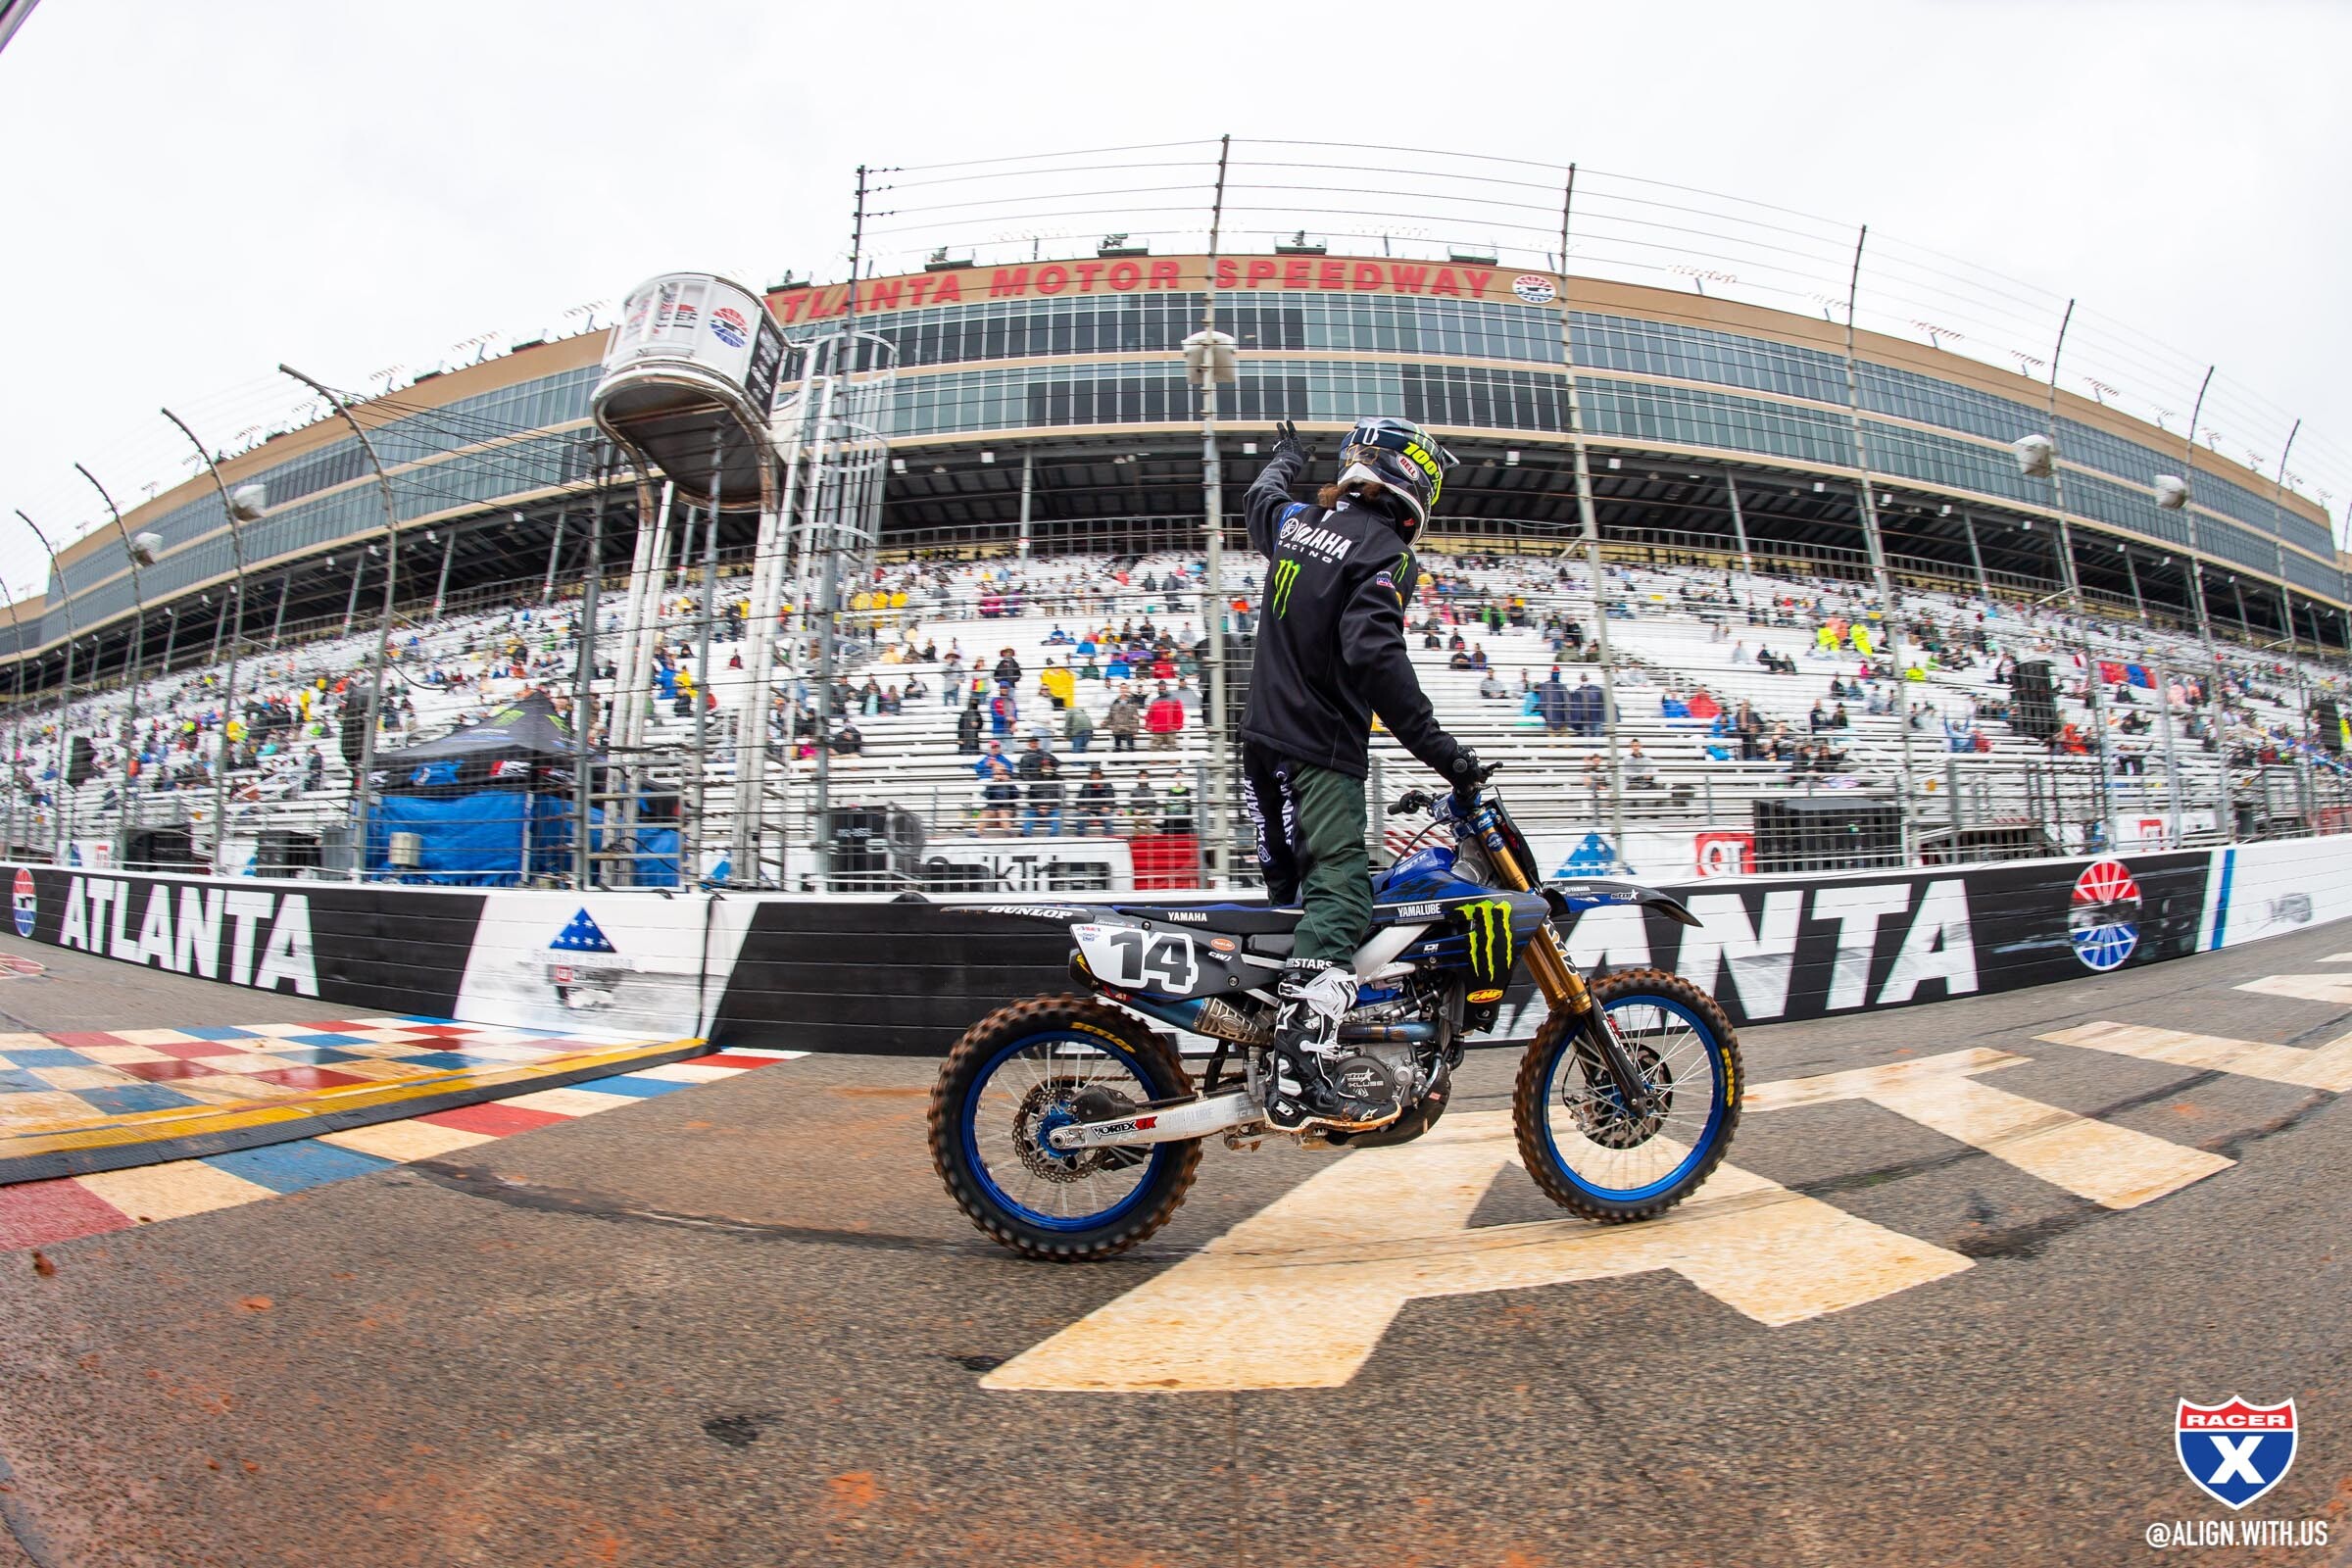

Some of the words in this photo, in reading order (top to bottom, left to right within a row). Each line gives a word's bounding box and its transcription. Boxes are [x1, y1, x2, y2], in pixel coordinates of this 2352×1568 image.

[990, 260, 1178, 297] MOTOR
[1215, 260, 1494, 298] SPEEDWAY
[1399, 458, 1416, 477] BELL
[1278, 540, 1333, 564] RACING
[1291, 521, 1352, 561] YAMAHA
[1244, 779, 1265, 843] YAMAHA
[1700, 840, 1746, 875] QT
[988, 906, 1073, 919] DUNLOP
[1167, 911, 1208, 922] YAMAHA
[1396, 904, 1442, 918] YAMALUBE
[59, 876, 319, 997] ATLANTA
[1110, 931, 1192, 987] 14
[1467, 989, 1504, 1003] FMF
[1092, 1120, 1137, 1140] VORTEX
